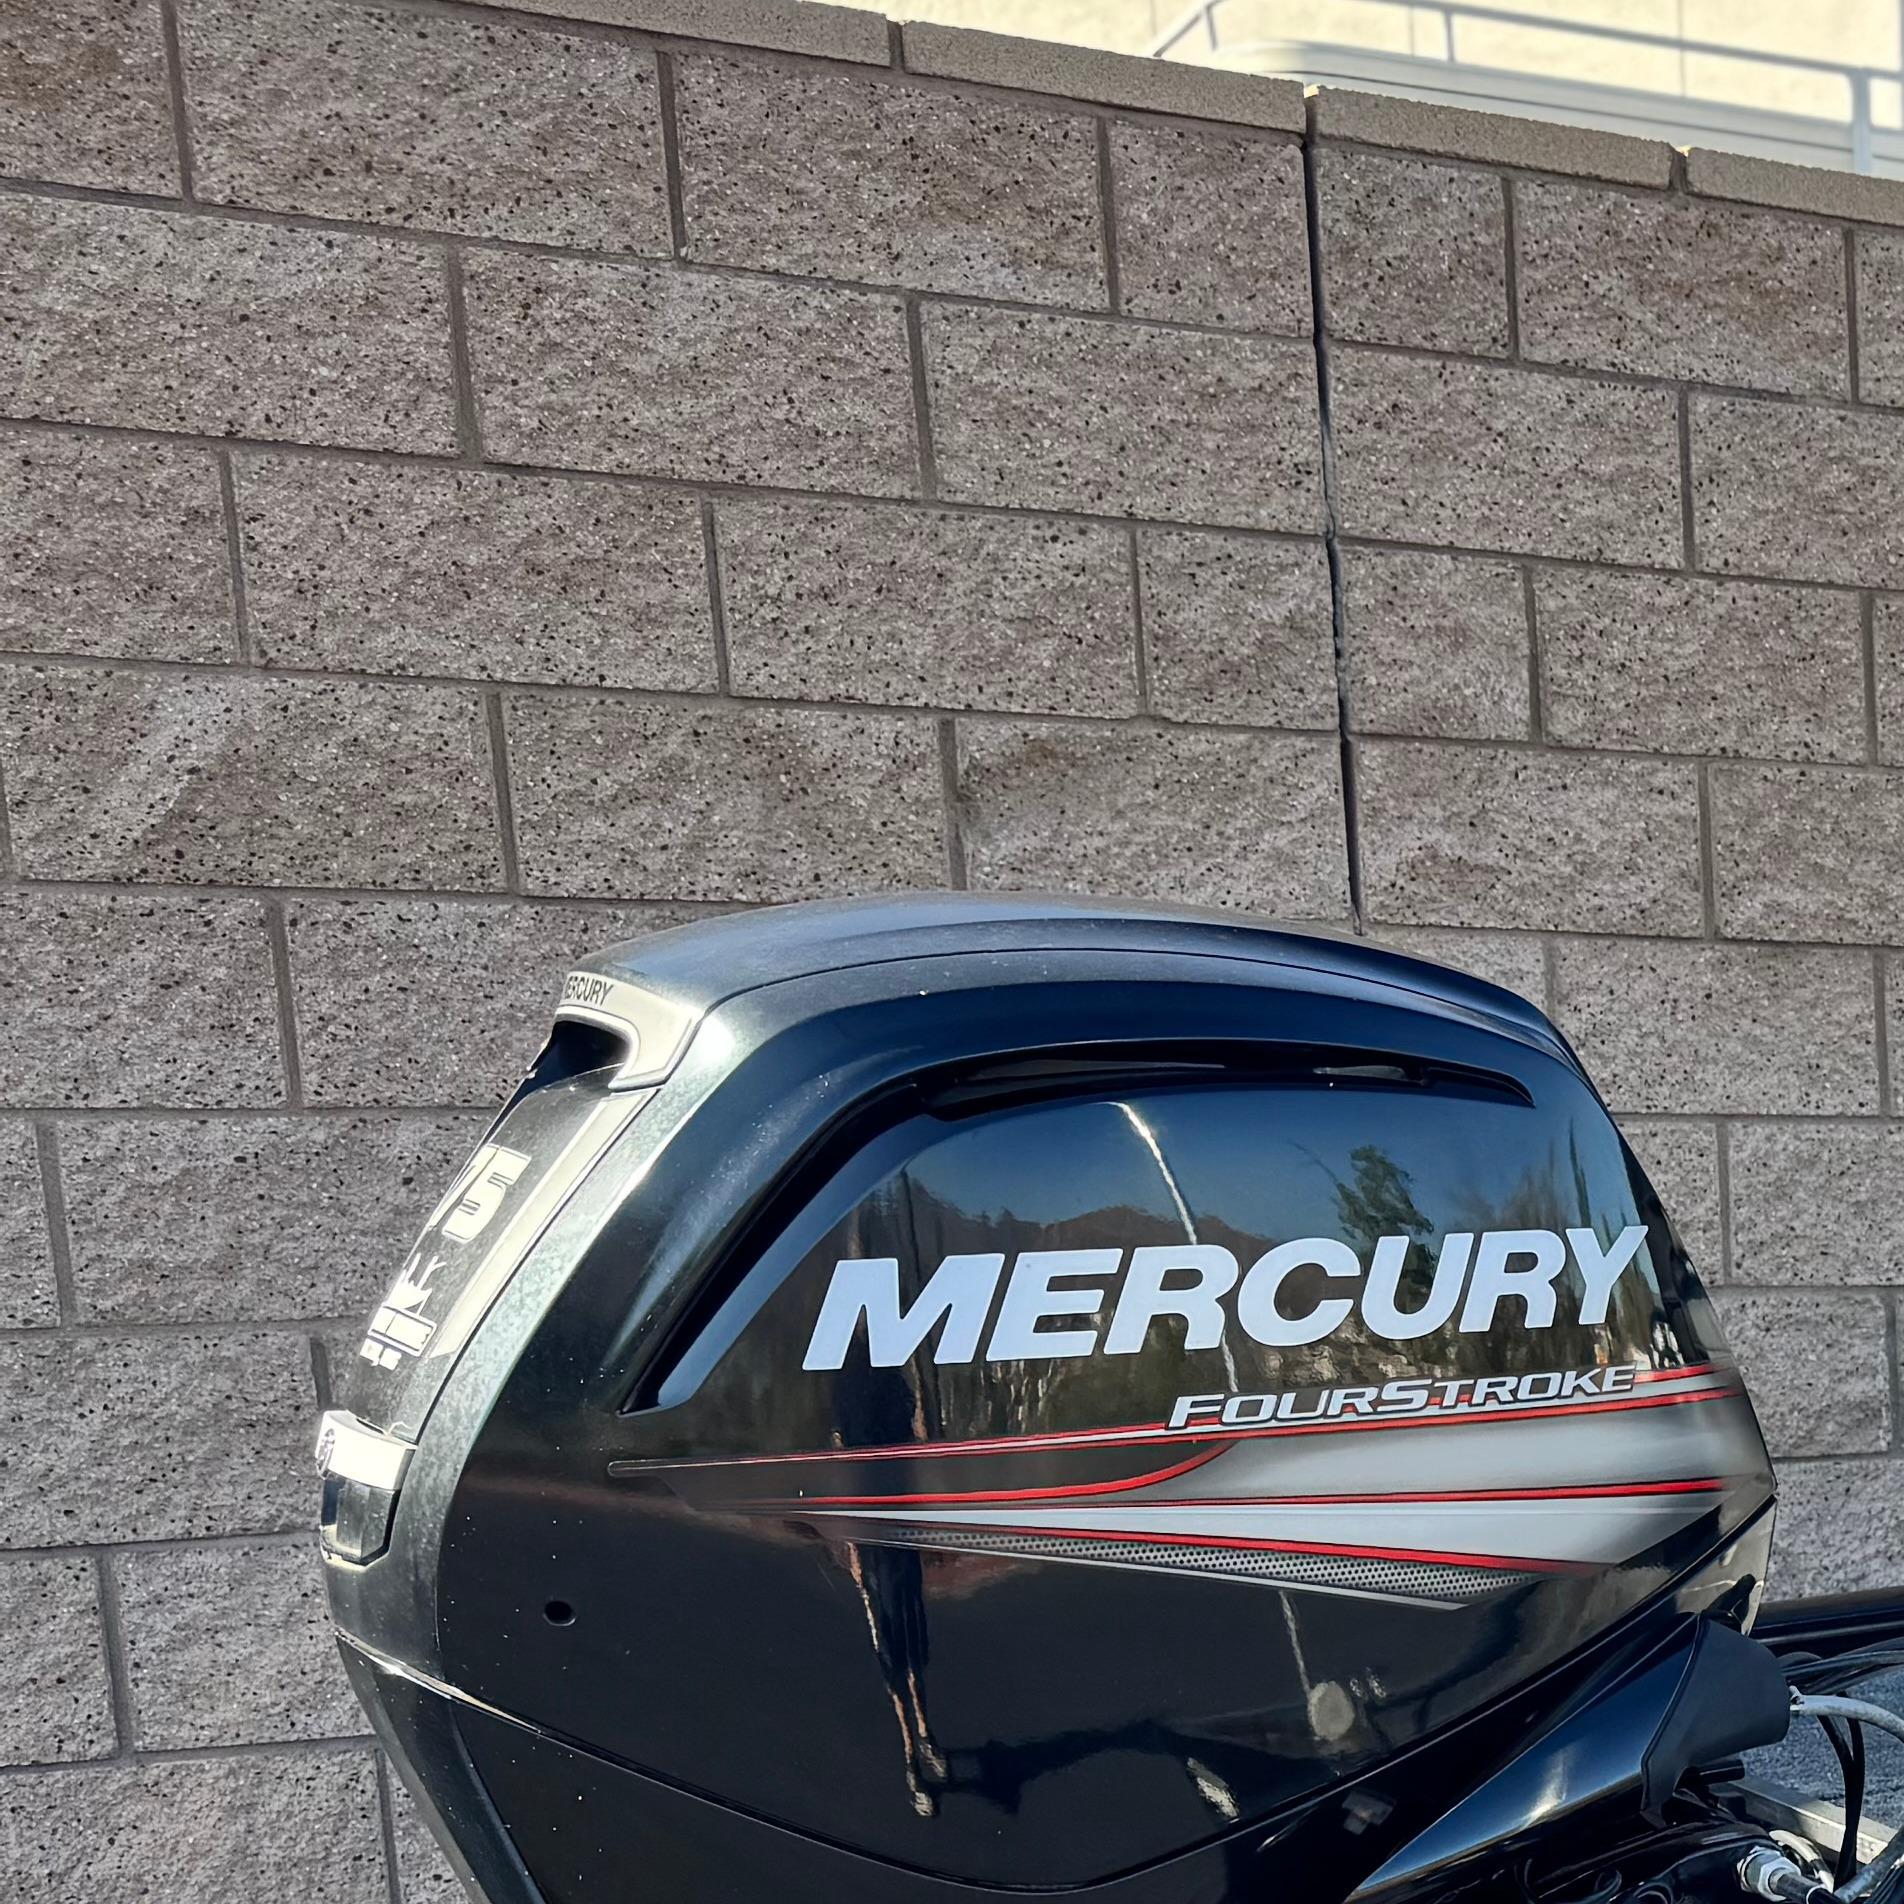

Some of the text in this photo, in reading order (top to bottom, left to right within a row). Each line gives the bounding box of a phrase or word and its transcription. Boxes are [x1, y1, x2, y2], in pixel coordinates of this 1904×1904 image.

[564, 976, 614, 1006] ERCURY
[802, 1224, 1650, 1371] MERCURY
[1166, 1363, 1638, 1432] FOURSTROKE
